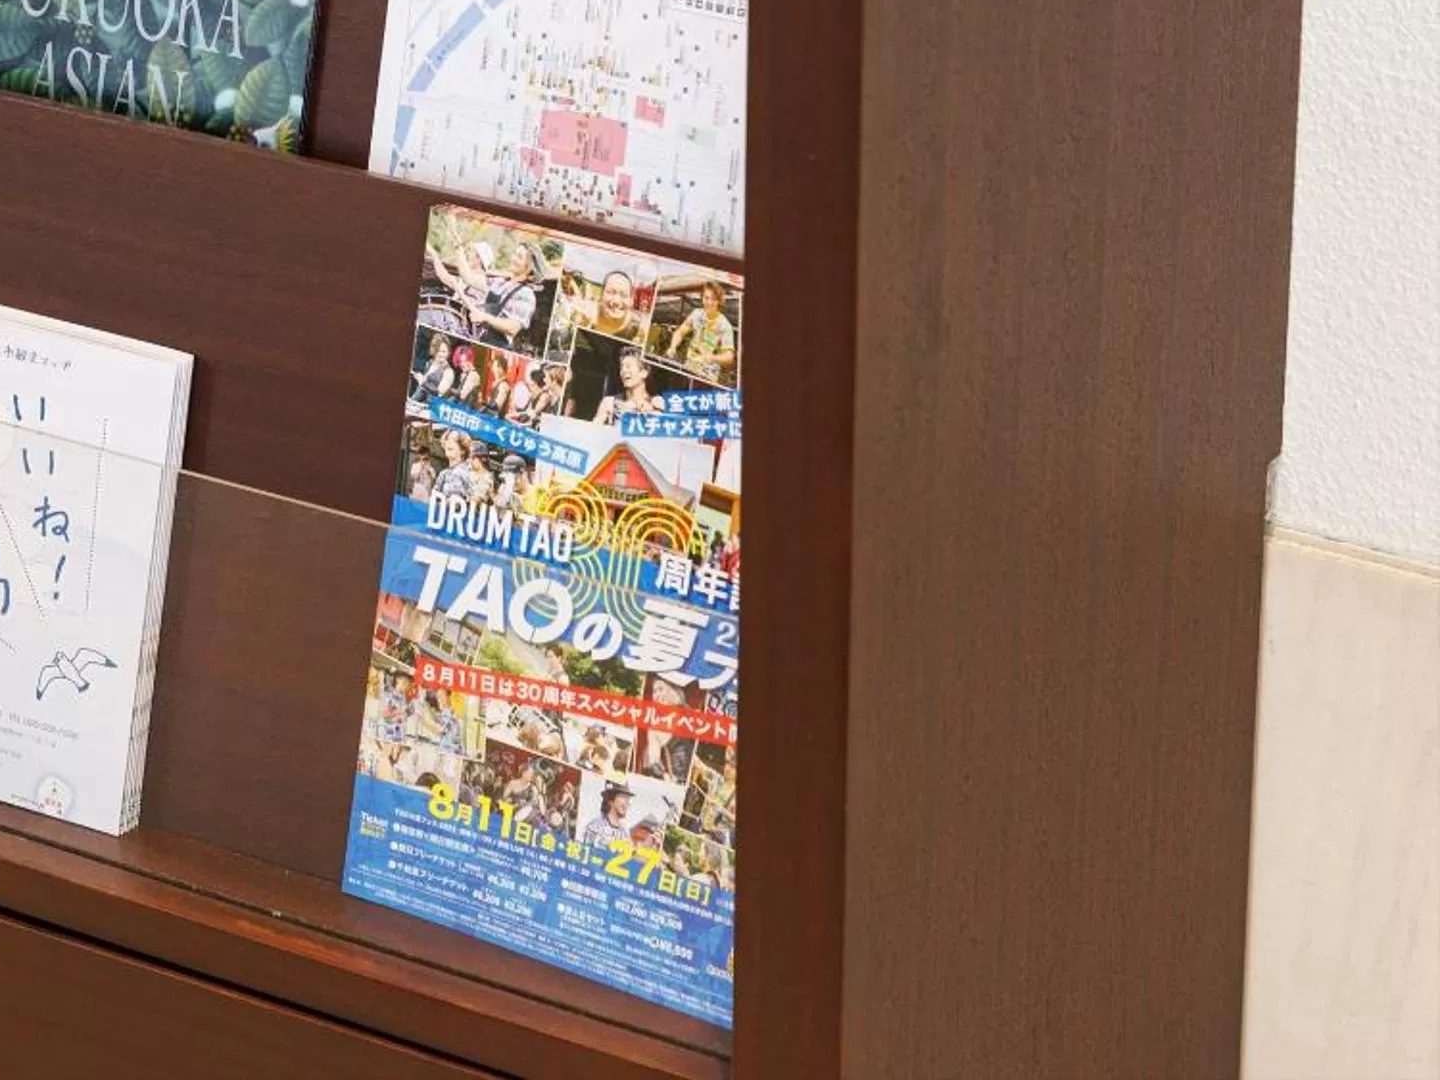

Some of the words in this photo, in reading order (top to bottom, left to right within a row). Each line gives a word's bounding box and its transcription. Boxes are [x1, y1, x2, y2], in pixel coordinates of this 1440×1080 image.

[31, 40, 190, 126] ASIAN
[426, 492, 510, 550] DRUM
[519, 514, 574, 563] TAO
